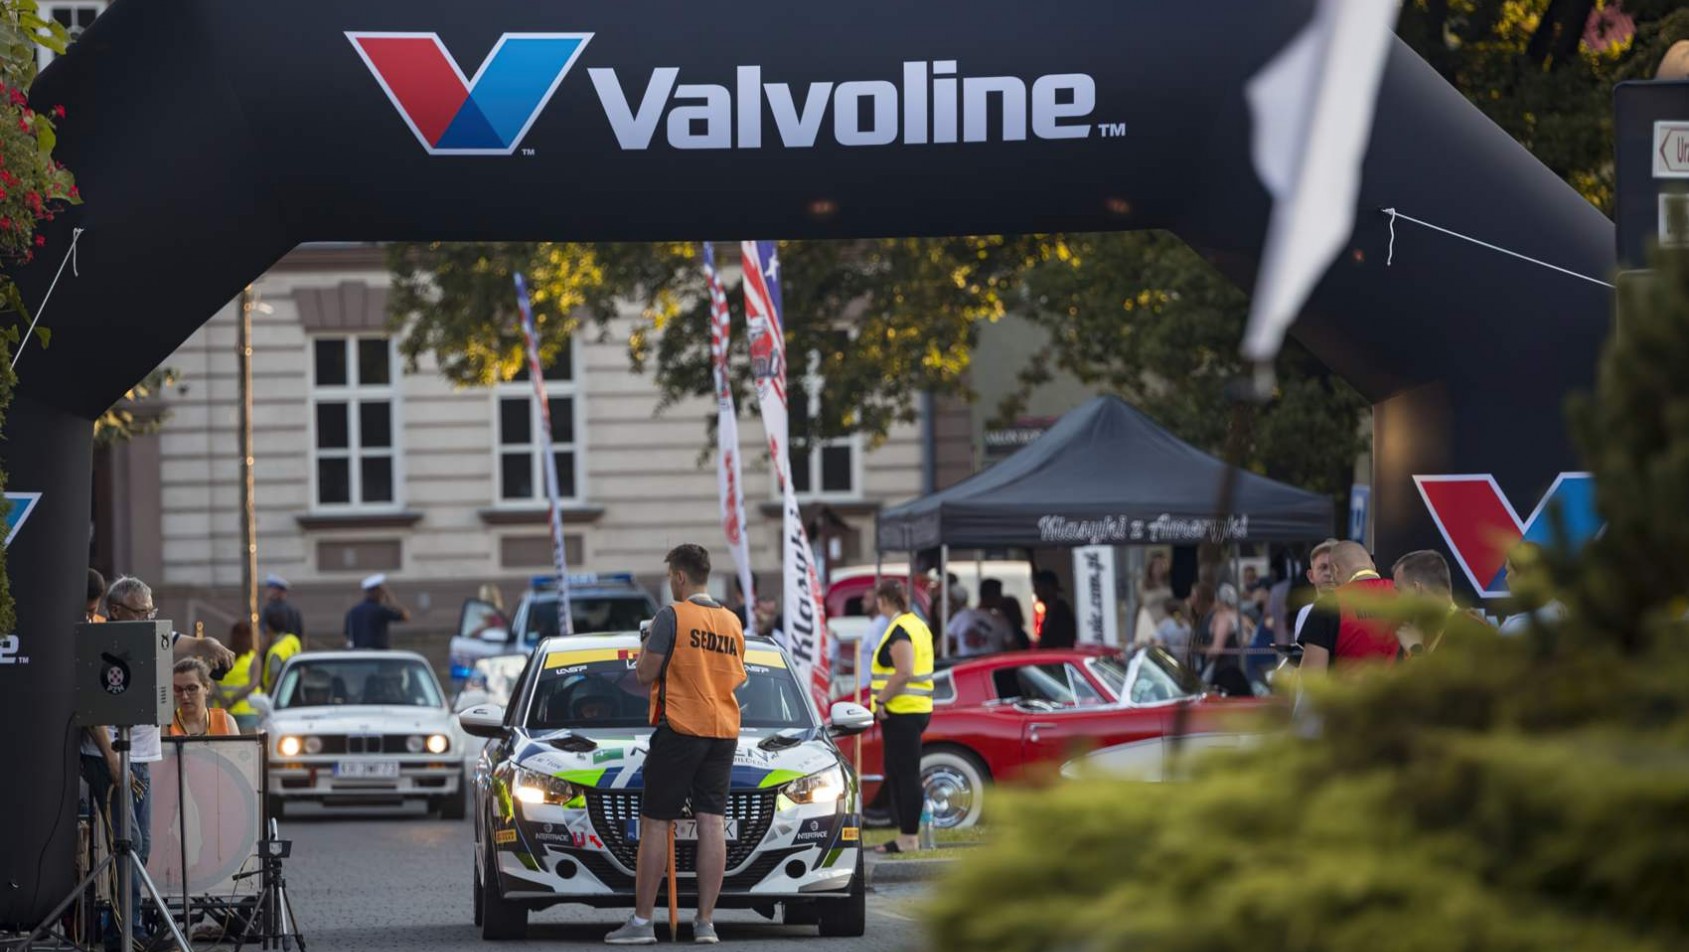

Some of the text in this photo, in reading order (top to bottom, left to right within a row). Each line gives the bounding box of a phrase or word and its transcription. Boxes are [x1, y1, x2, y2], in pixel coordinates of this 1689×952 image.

[587, 60, 1126, 150] Valvoline TM
[1037, 514, 1128, 544] Klasyki
[1130, 519, 1144, 539] z
